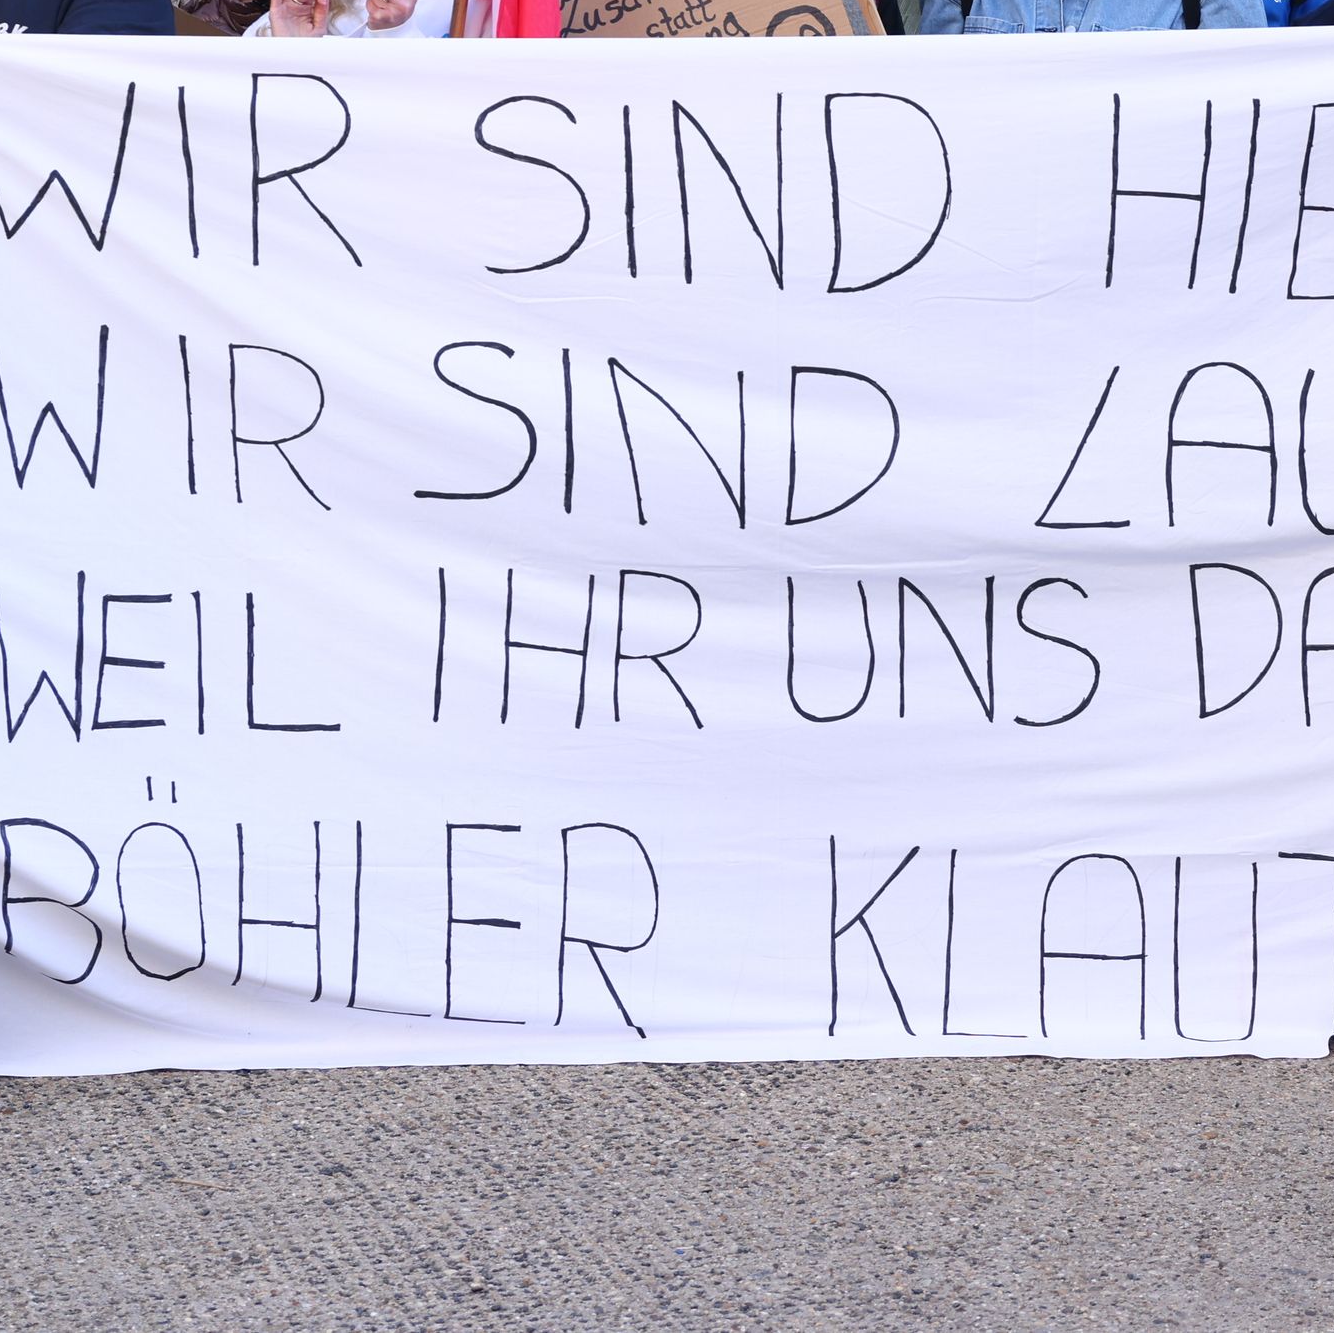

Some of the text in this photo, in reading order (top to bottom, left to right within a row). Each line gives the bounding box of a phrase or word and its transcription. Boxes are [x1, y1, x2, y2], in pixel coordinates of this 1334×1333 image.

[473, 90, 954, 294] SIND
[413, 339, 901, 531] SIND
[432, 565, 705, 731] IHR
[785, 573, 1102, 728] UNS
